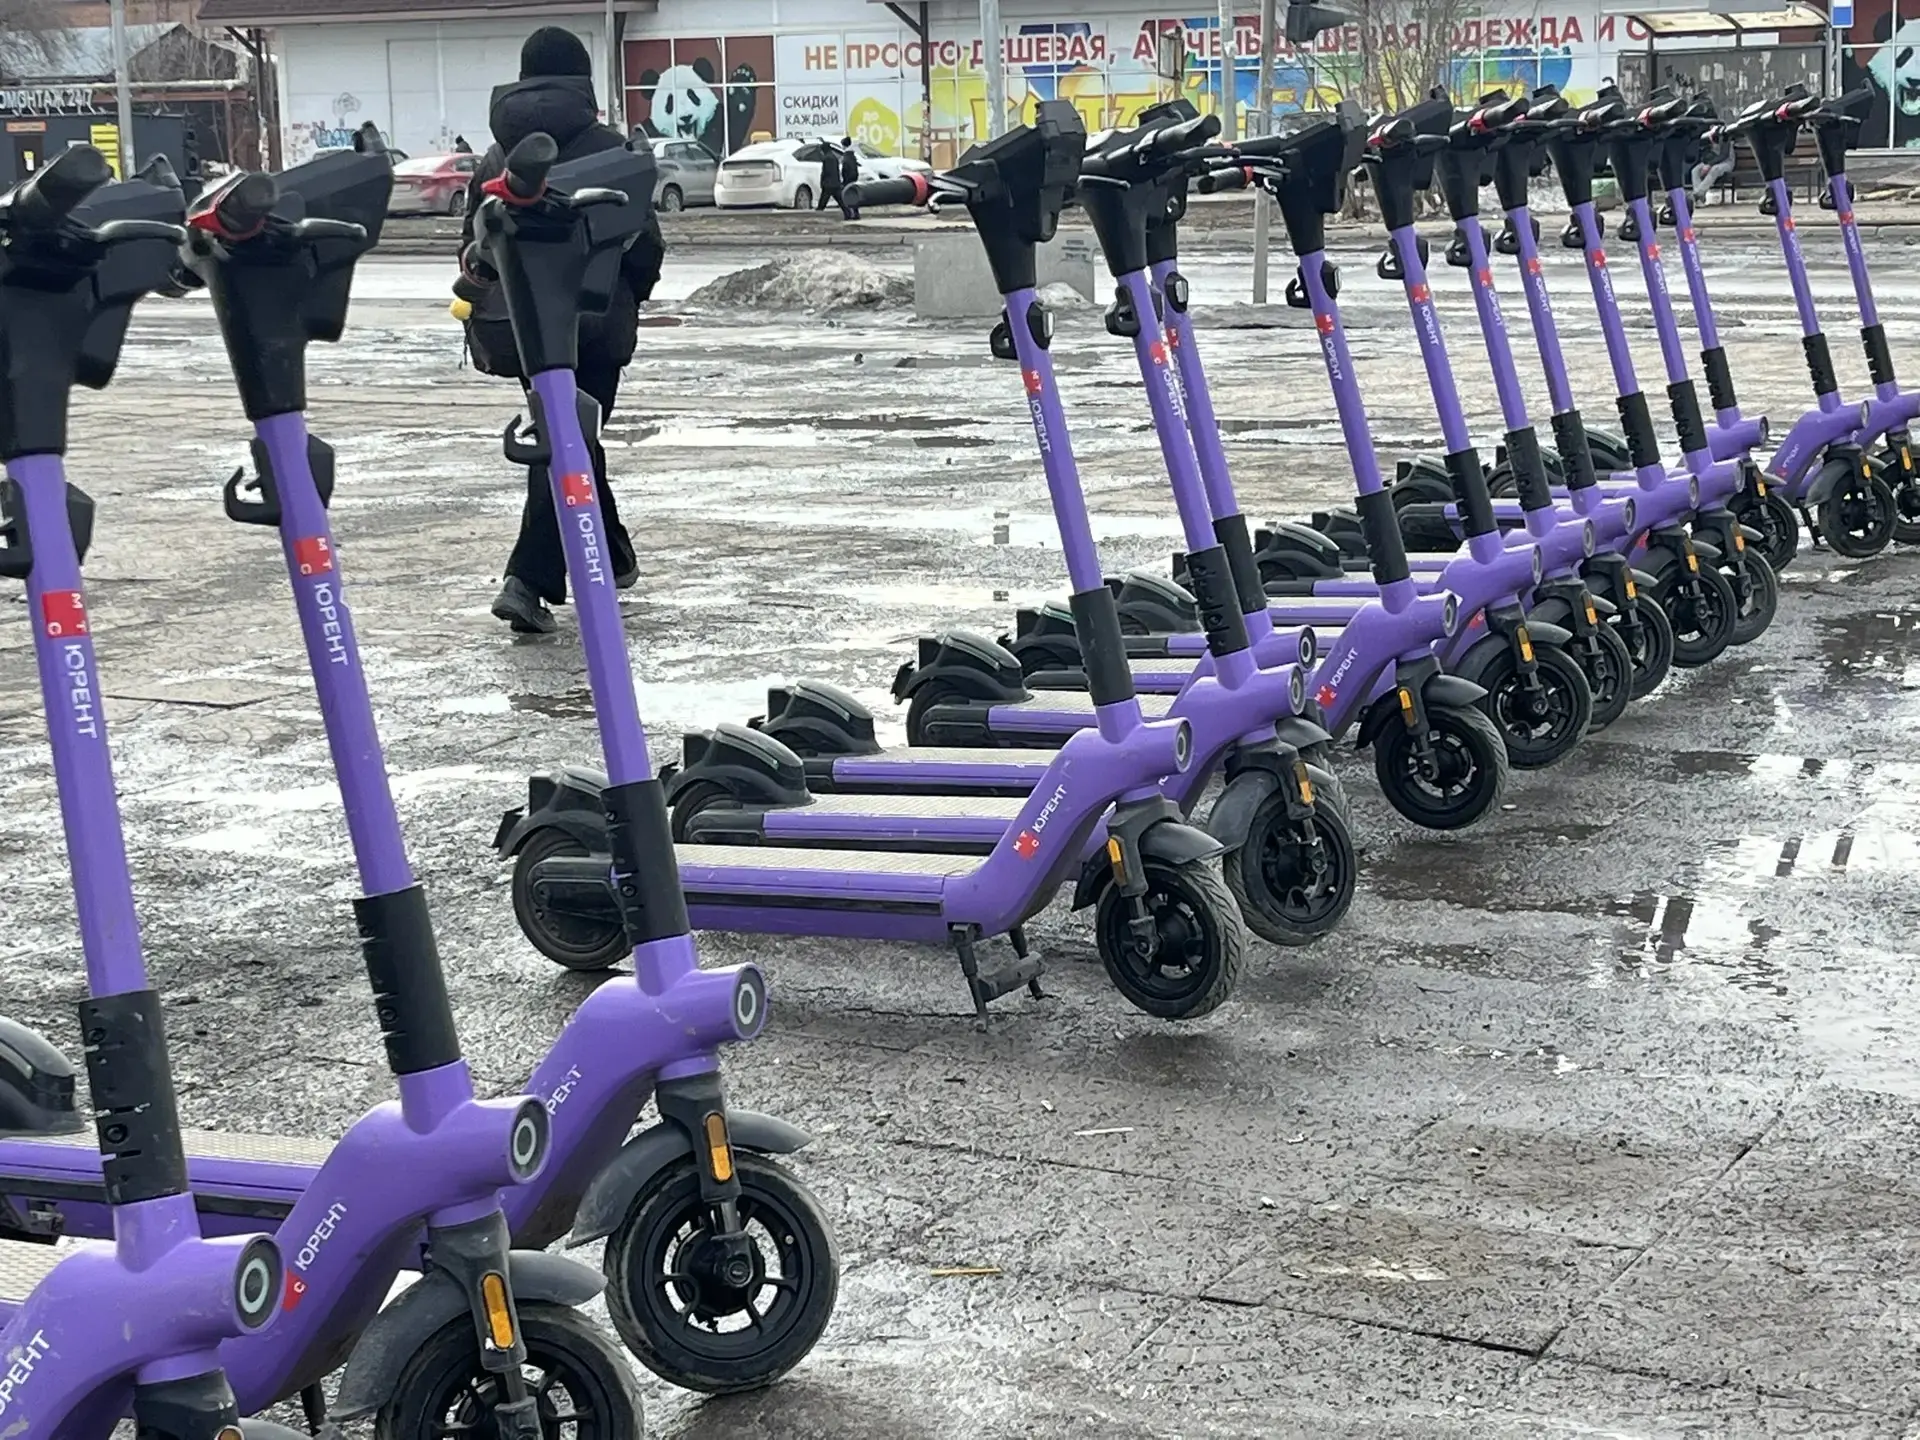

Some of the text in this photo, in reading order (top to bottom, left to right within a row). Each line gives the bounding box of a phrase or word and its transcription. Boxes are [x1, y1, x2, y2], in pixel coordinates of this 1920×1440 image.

[804, 45, 838, 70] НЕ
[846, 40, 961, 69] ПРОСТО
[971, 34, 1116, 69] ДШЕВАЯ,
[1594, 15, 1615, 42] И
[783, 95, 839, 110] СКИДКИ
[785, 111, 839, 126] КАЖДЫЙ
[1421, 305, 1440, 346] ЮРЕНТ
[1325, 337, 1342, 380] ЮРЕНТ
[1162, 368, 1182, 417] ЮРЕНТ
[1031, 399, 1051, 453] ЮРЕНТ
[577, 512, 605, 586] ЮРЕНТ
[313, 582, 348, 666] ЮРЕНТ
[64, 644, 97, 739] ЮРЕНТ
[1330, 647, 1358, 687] ЮРЕНТ
[1031, 784, 1067, 833] ЮРЕНТ
[546, 1064, 581, 1116] РЕНТ
